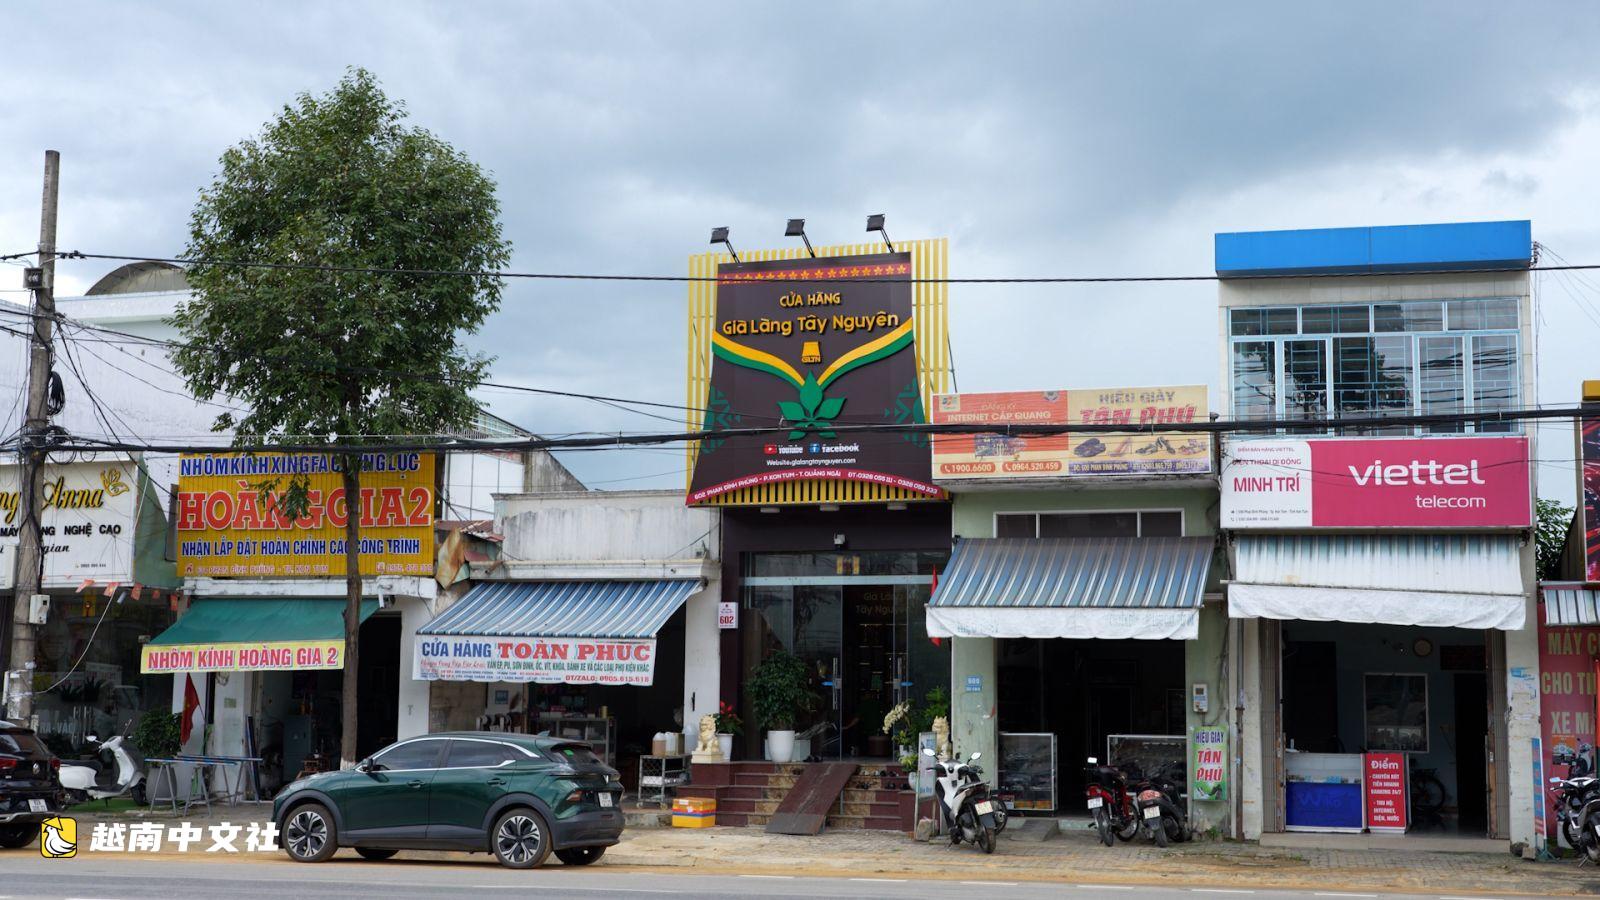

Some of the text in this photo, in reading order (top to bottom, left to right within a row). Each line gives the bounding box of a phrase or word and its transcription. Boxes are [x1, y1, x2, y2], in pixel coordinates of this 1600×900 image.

[780, 291, 804, 307] CỬA
[797, 315, 828, 334] Tây
[833, 311, 900, 333] Nguyên
[947, 413, 989, 423] INTERNET
[1015, 410, 1052, 421] QUANG
[181, 454, 229, 476] NHÔM
[231, 453, 269, 475] KÍNH
[951, 464, 992, 473] 1900.6600
[1348, 459, 1486, 486] viettel
[1234, 472, 1300, 492] MINH TRÍ
[178, 480, 325, 530] HOÀNG
[1415, 495, 1487, 508] telecom
[64, 522, 92, 540] NGHỆ
[99, 525, 121, 538] CAO
[182, 537, 211, 560] NHẬN
[261, 537, 290, 556] HOÀN
[386, 536, 420, 555] TRÌNH
[719, 616, 735, 625] 602
[422, 637, 450, 657] CỬA
[453, 640, 492, 658] HÀNG
[497, 640, 569, 660] TOÀN
[1547, 628, 1600, 657] MÁY C
[148, 645, 338, 670] NHÔM KÍNH HOÀNG GIA 2
[1541, 672, 1573, 695] CHO
[1551, 711, 1571, 735] XE
[1194, 731, 1209, 746] HIỆU
[1198, 748, 1222, 763] TÂN
[1371, 757, 1399, 770] Điểm
[1196, 766, 1223, 781] PHÚ
